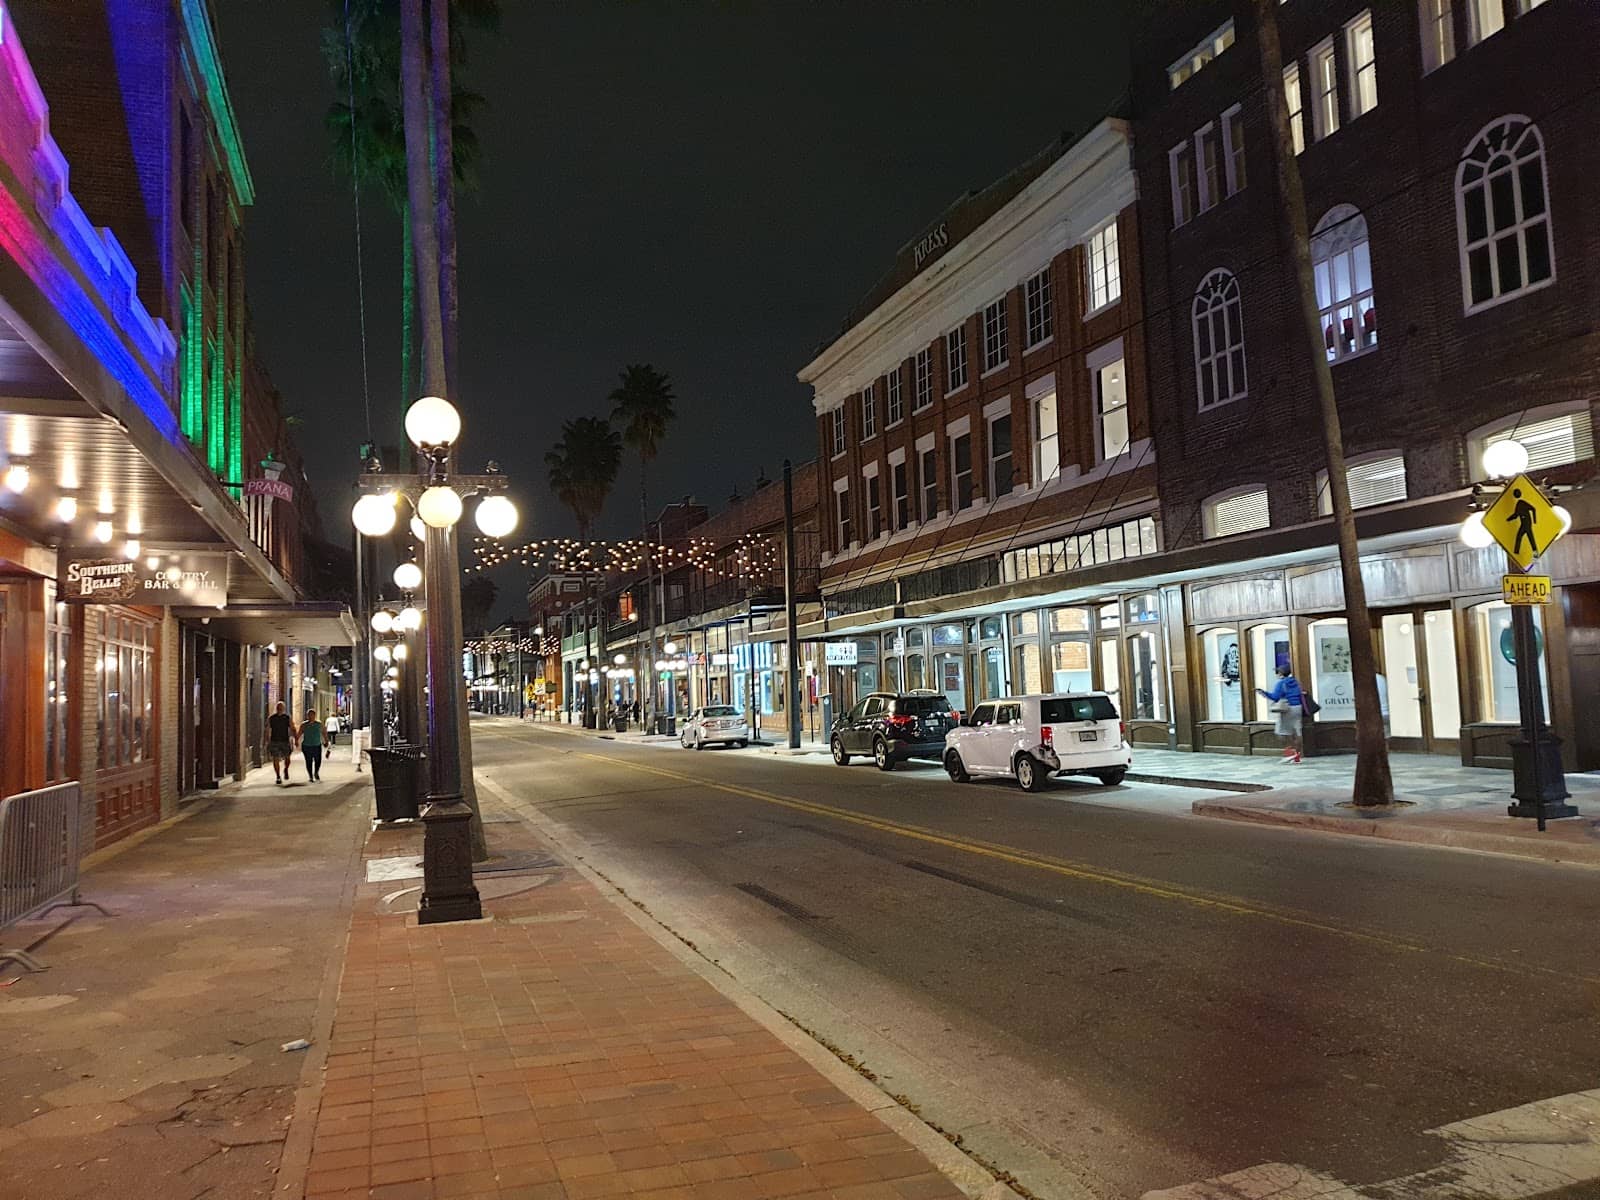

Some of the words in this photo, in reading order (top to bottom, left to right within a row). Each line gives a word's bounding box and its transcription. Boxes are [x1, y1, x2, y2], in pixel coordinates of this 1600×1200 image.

[247, 481, 290, 498] PRANA
[67, 562, 135, 582] SOUTHERN
[155, 570, 209, 581] CONTRY
[80, 576, 122, 595] BELLE
[144, 579, 170, 589] BAR
[182, 580, 218, 590] ILL
[1510, 582, 1547, 597] AHEAD
